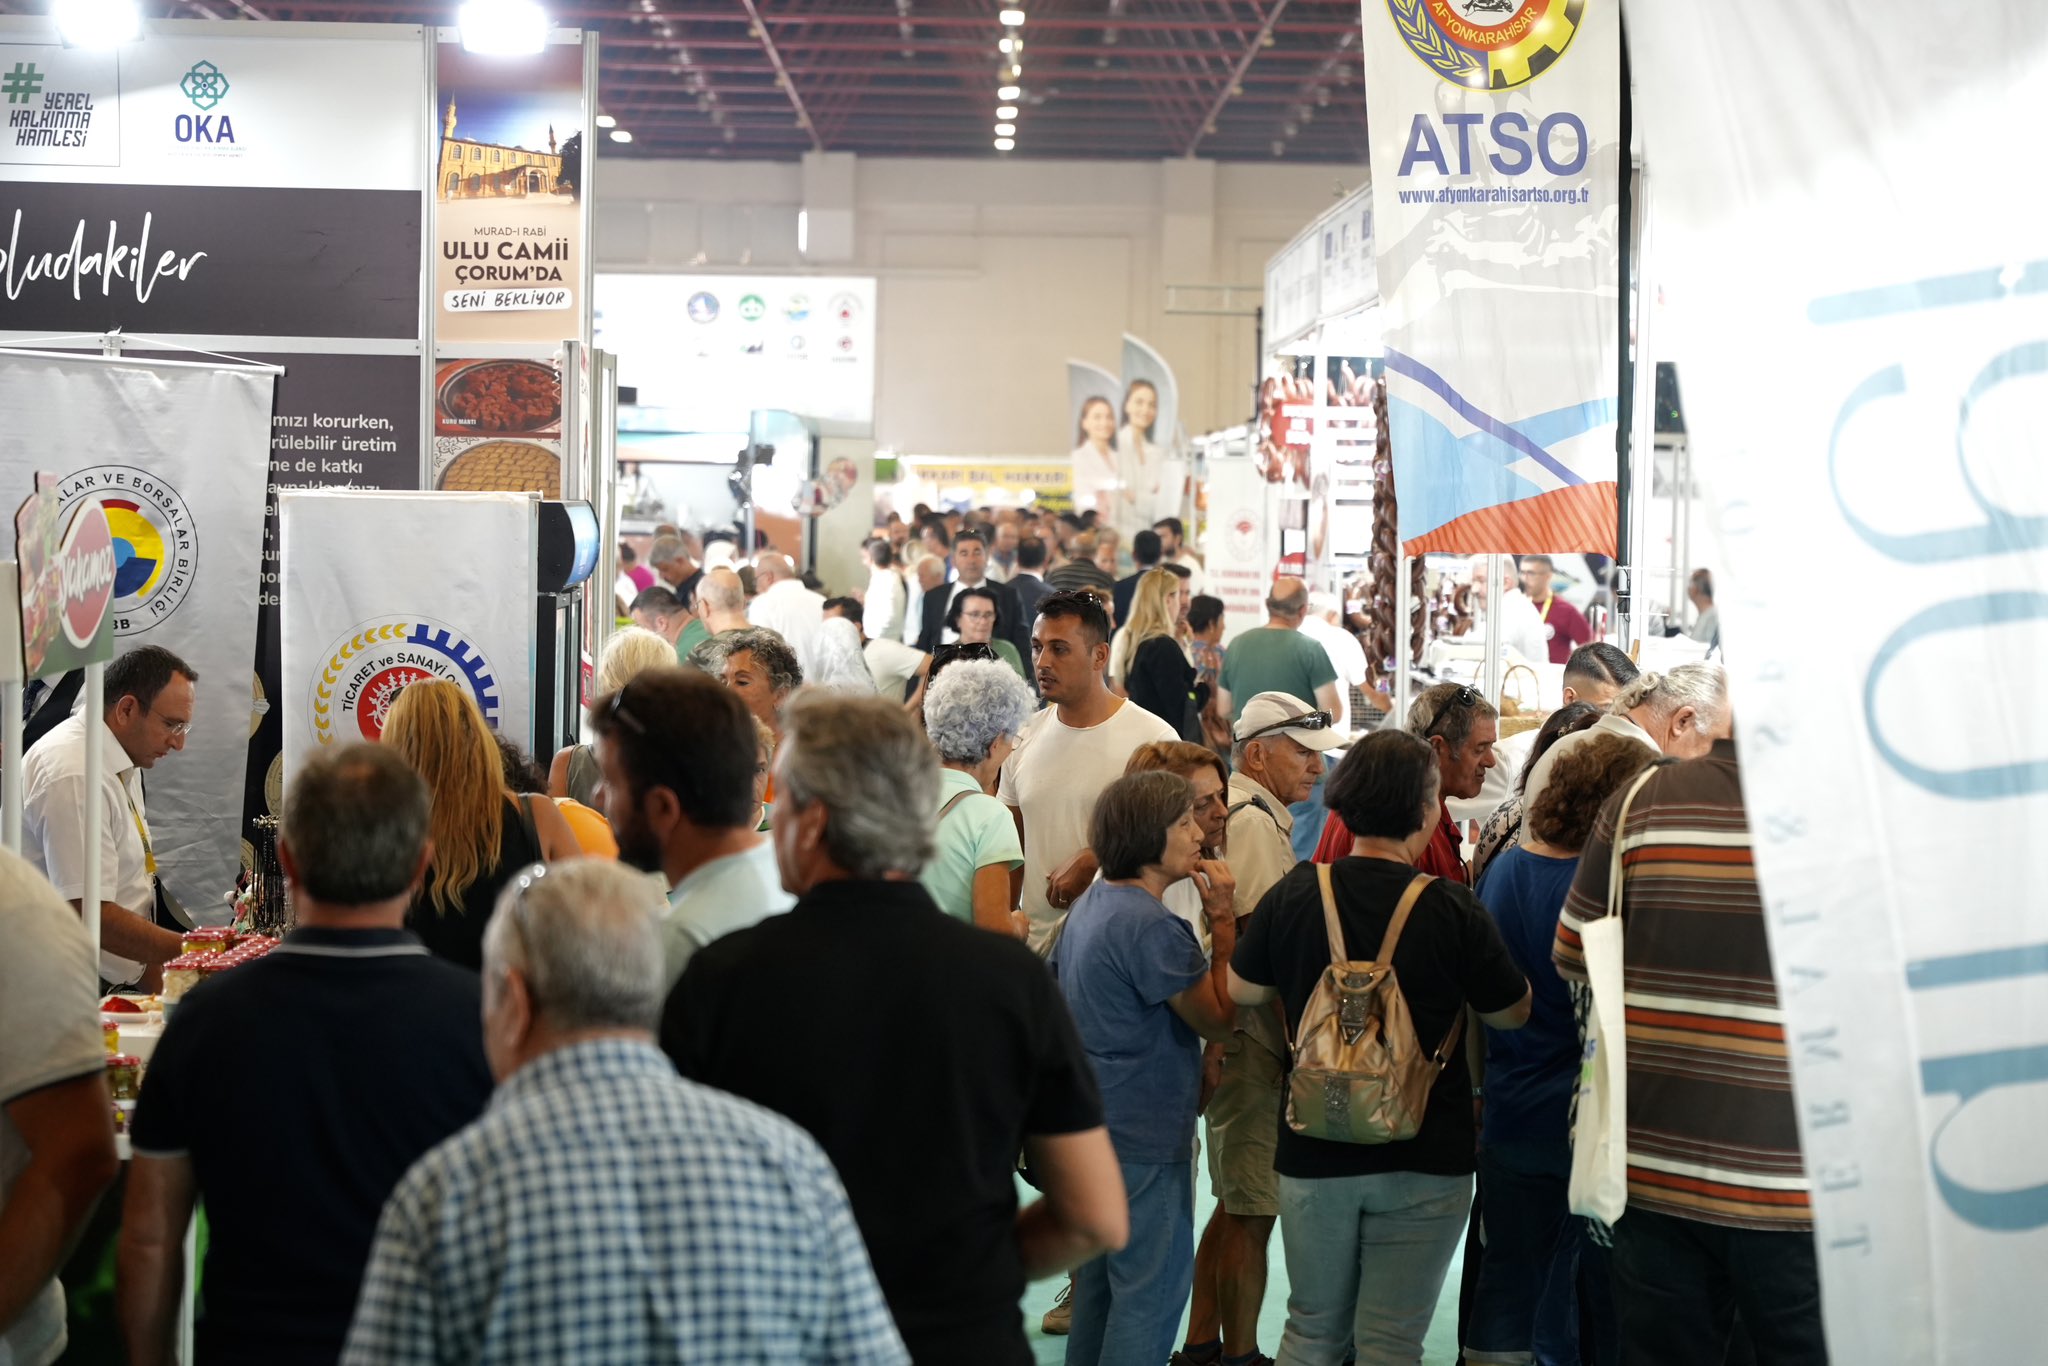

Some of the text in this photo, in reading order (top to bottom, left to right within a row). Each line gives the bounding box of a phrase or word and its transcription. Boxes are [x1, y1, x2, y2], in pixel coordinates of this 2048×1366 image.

[1432, 2, 1538, 45] AFYONKARAHİSAR
[44, 92, 94, 111] YEREL
[9, 110, 91, 129] KALKINMA
[175, 114, 236, 144] OKA
[1397, 112, 1589, 177] ATSO
[1399, 186, 1589, 204] www.afyonkarahisartso.org.tr
[474, 226, 521, 237] MURAD-I
[443, 238, 569, 261] ULU CAMİİ
[455, 265, 563, 285] ÇORUM'DA
[451, 290, 566, 309] SENİ BEKLİYOR
[313, 413, 394, 432] korurken,
[272, 435, 397, 452] rülebilir üretim
[270, 458, 363, 474] ne de katkı
[104, 473, 125, 484] VE
[133, 477, 189, 550] BORSALAR
[342, 660, 377, 712] TİCARET
[379, 656, 394, 667] ve
[397, 653, 448, 676] SANAYİ
